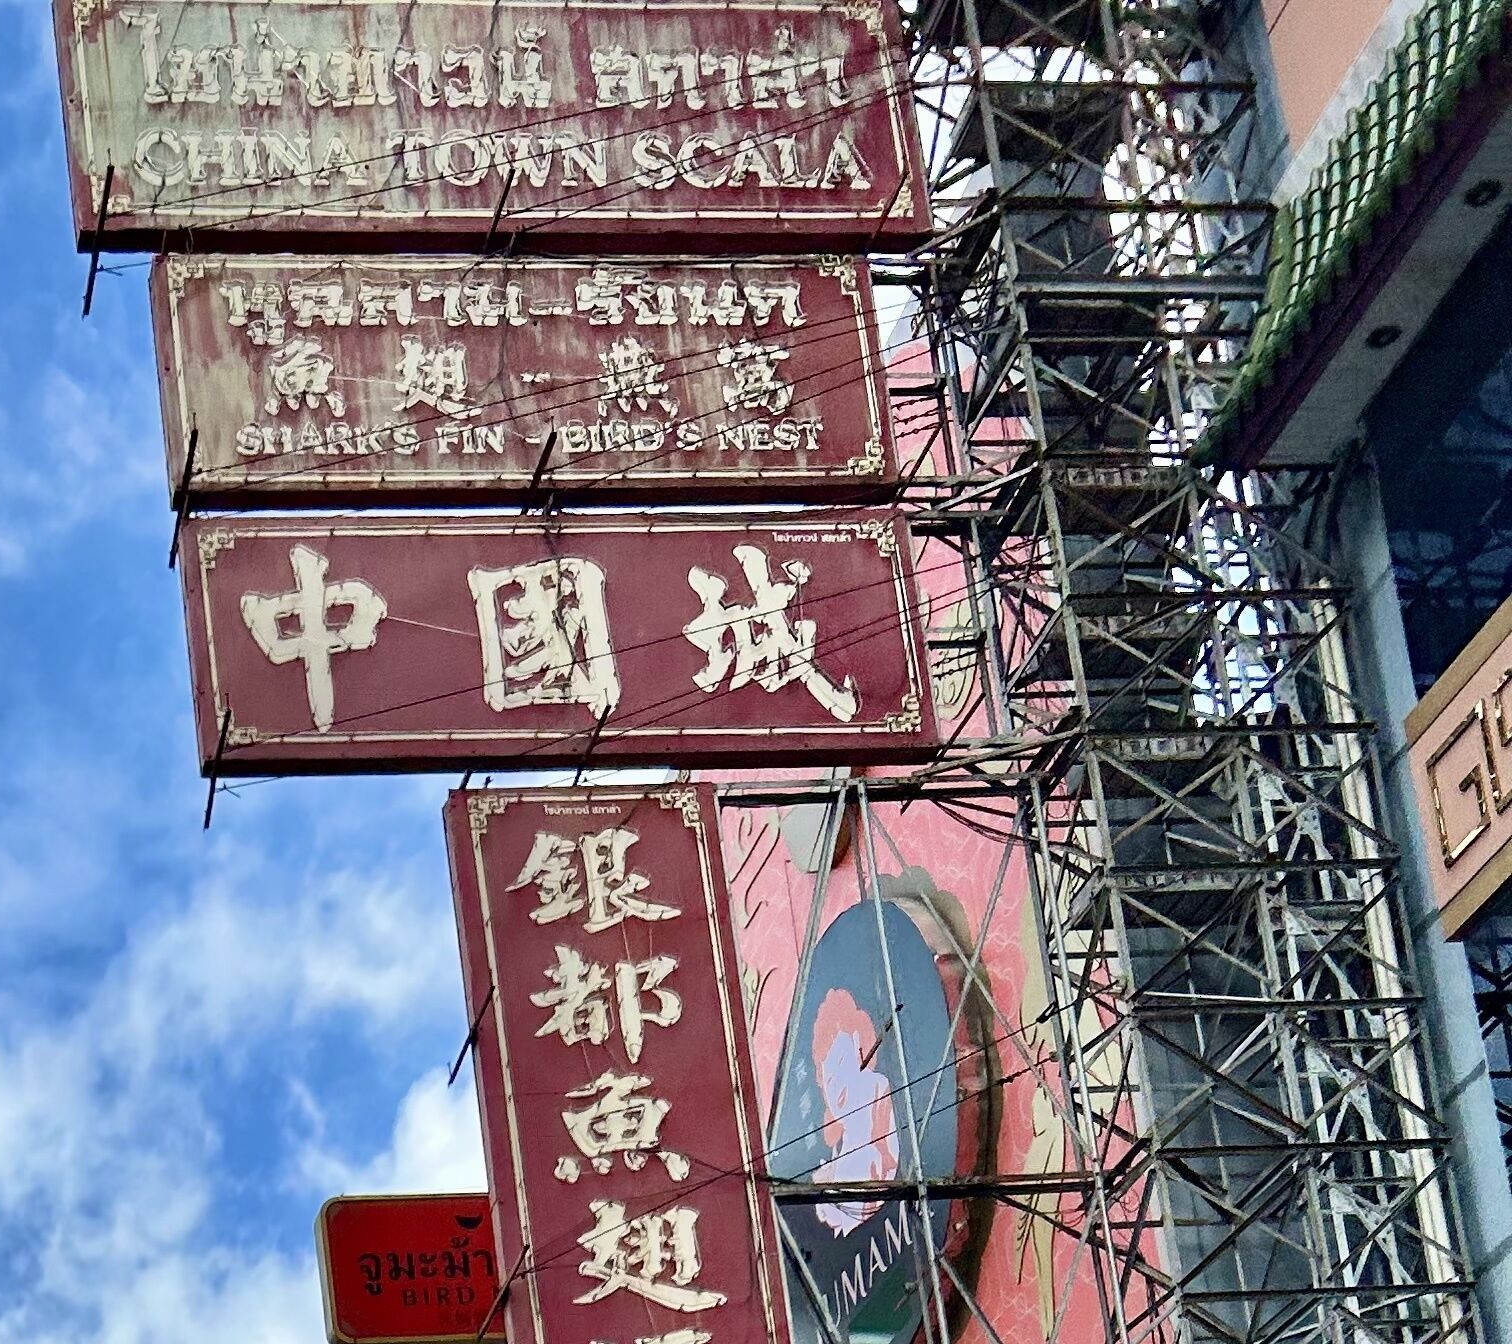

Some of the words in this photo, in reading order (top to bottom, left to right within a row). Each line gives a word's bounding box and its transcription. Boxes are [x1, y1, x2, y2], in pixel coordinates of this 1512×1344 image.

[134, 127, 368, 187] CHINA
[386, 128, 610, 188] TOWN
[634, 130, 869, 190] SCALA
[434, 422, 505, 455] FIN
[716, 417, 824, 451] NEST
[240, 543, 862, 733] 中國城
[401, 1284, 477, 1308] BIRD
